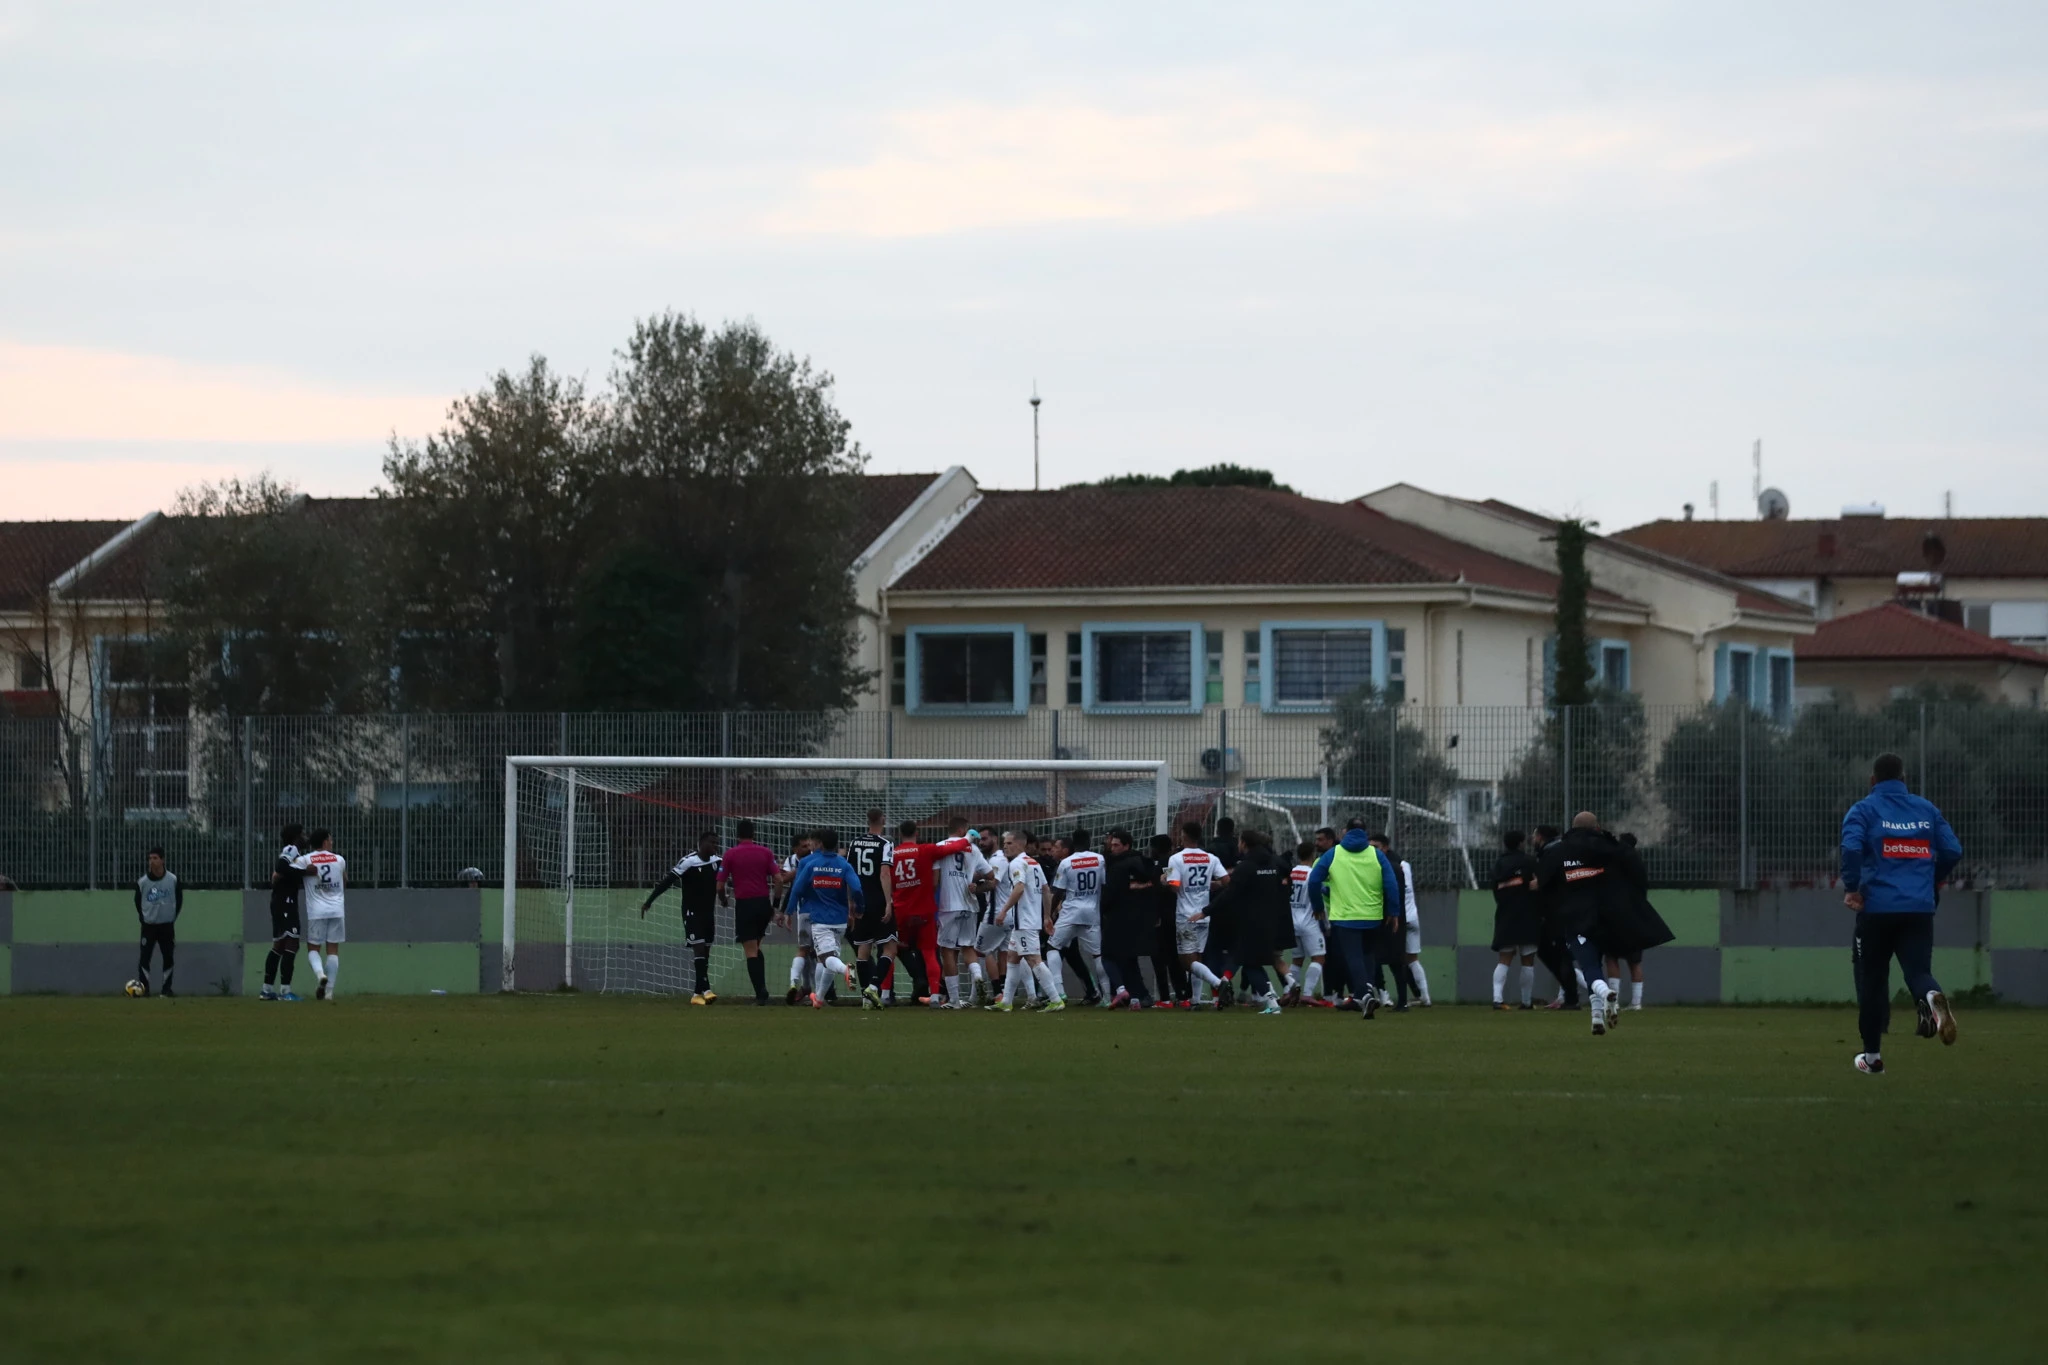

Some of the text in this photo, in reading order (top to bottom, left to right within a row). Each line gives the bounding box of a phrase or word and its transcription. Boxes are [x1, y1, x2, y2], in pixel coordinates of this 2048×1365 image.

[1882, 820, 1930, 830] IRAKLIS FC
[1883, 843, 1929, 854] betsson
[854, 847, 875, 876] 15
[895, 858, 916, 881] 43
[955, 852, 964, 871] 9
[321, 864, 331, 883] 2
[1033, 868, 1040, 888] 6
[1077, 871, 1096, 890] 80
[1189, 866, 1207, 886] 23
[1020, 936, 1026, 947] 6
